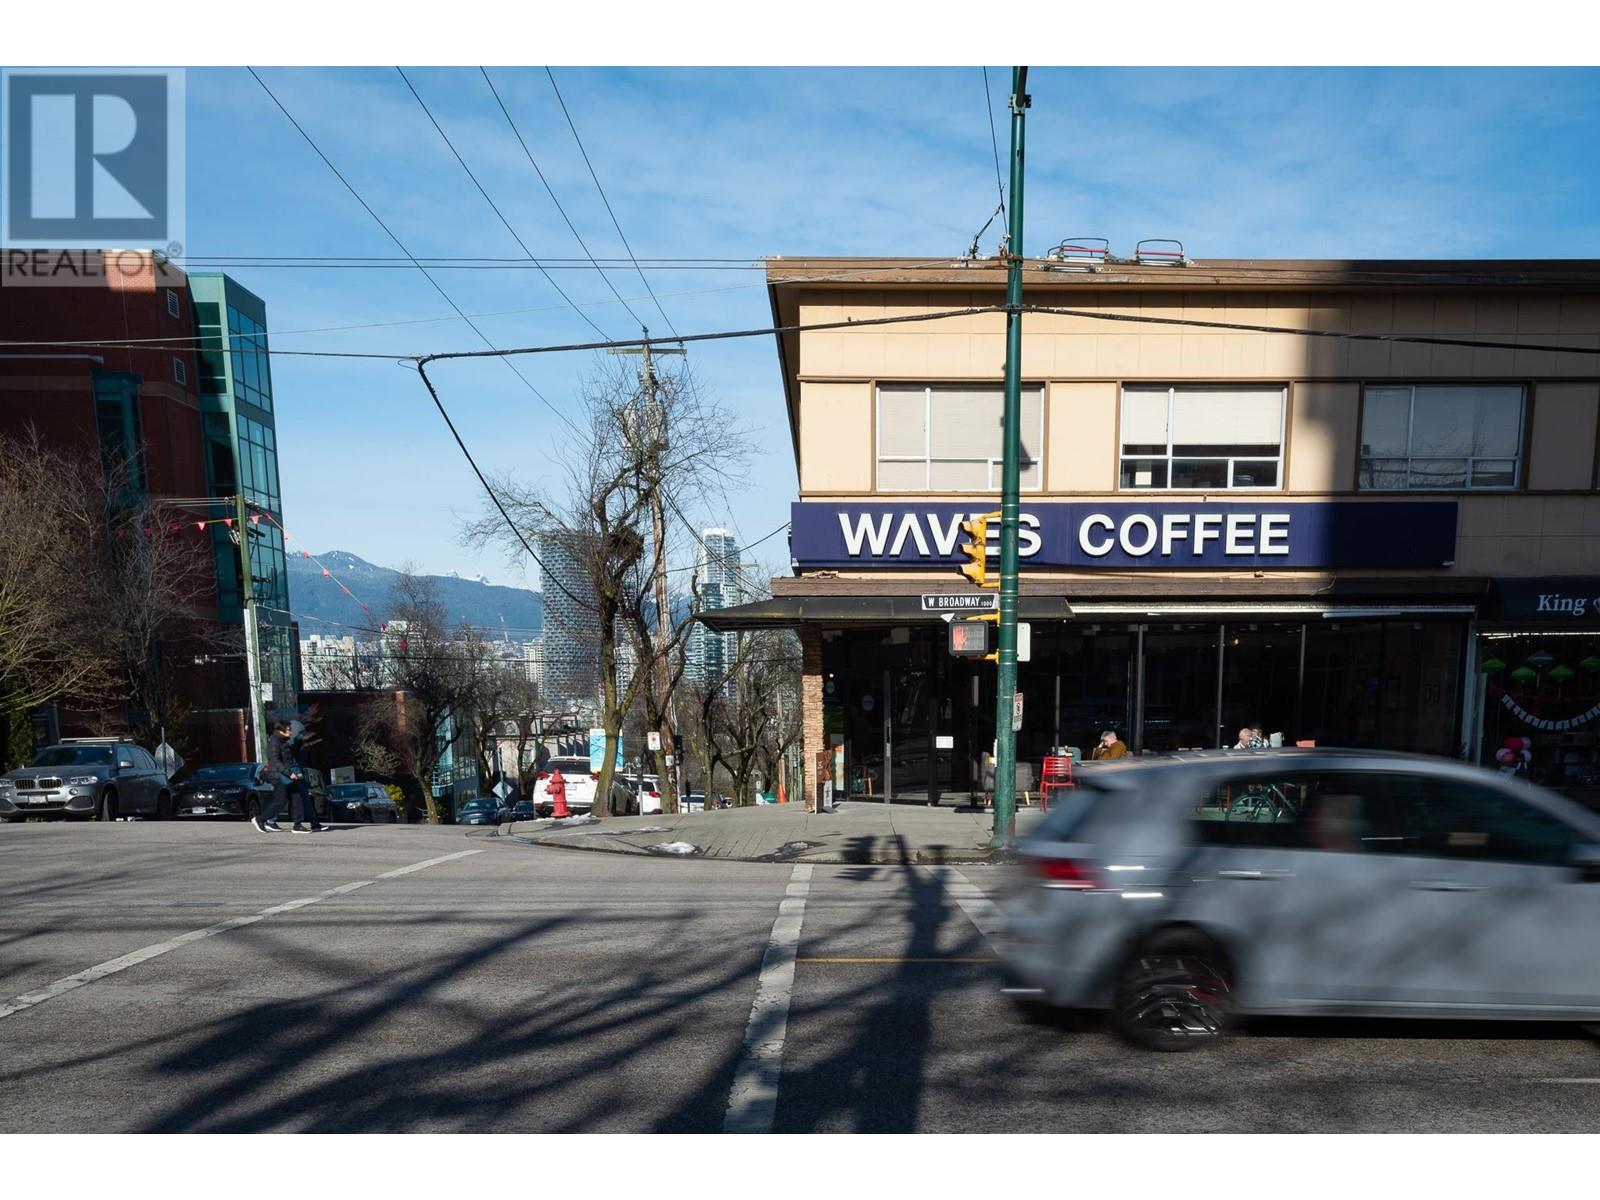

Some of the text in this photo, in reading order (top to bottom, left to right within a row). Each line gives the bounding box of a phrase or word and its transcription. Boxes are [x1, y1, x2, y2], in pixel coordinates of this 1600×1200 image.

[838, 512, 1291, 557] WAVES COFFEE
[928, 597, 935, 607] W
[938, 597, 980, 607] BROADWAY
[1537, 594, 1587, 615] King
